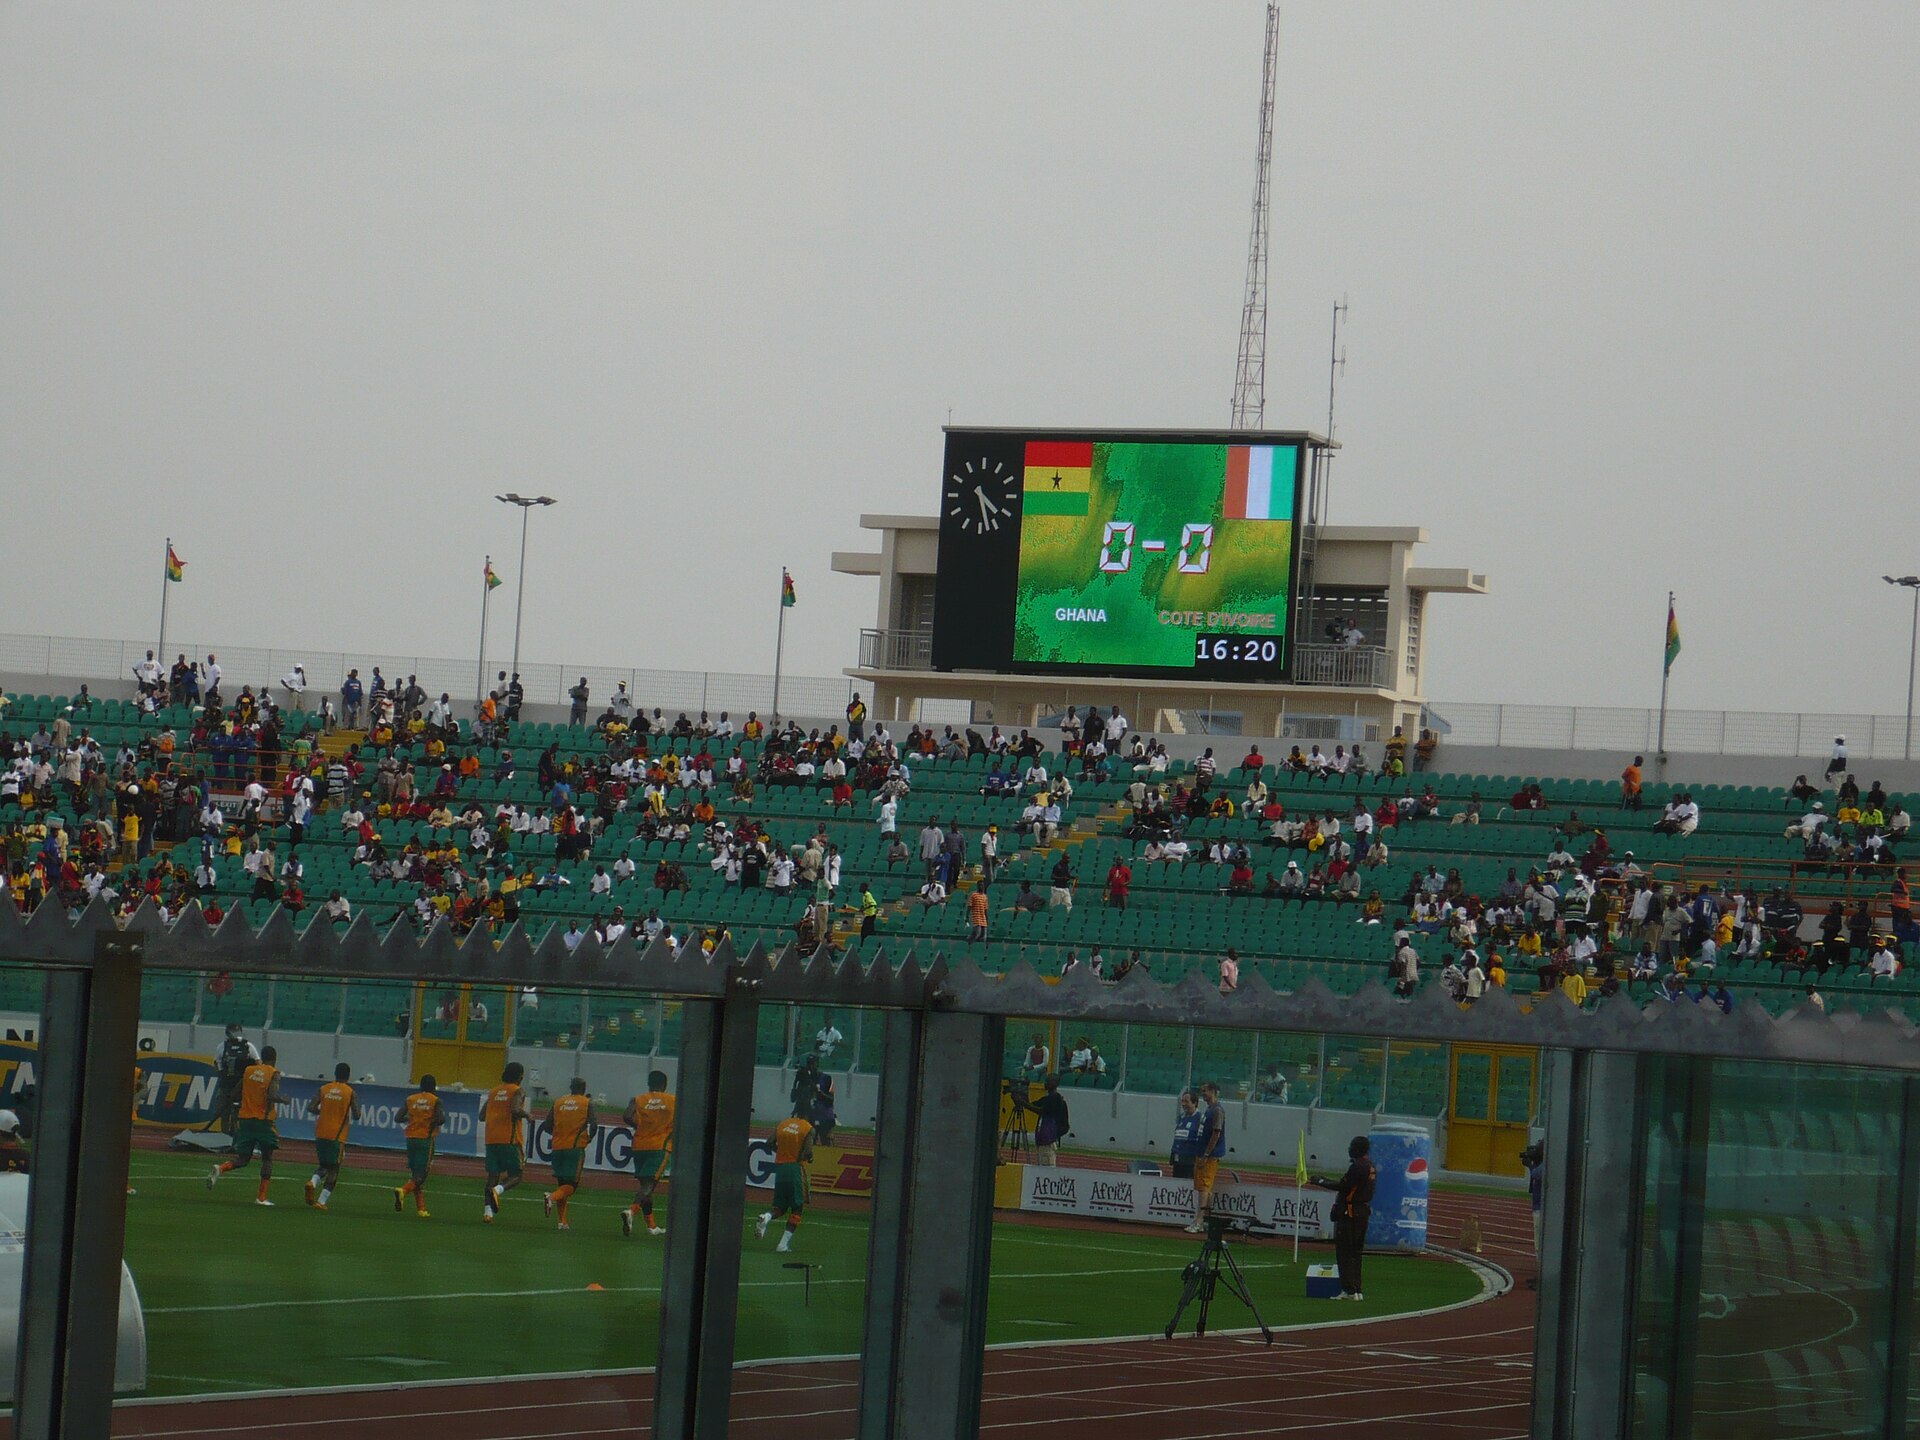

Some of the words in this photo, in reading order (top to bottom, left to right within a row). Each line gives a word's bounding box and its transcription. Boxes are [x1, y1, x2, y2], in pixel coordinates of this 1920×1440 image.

[1055, 607, 1107, 622] GHANA
[1158, 610, 1203, 626] COTE
[1207, 611, 1276, 628] D'IVOIRE
[1196, 638, 1276, 662] 16:20
